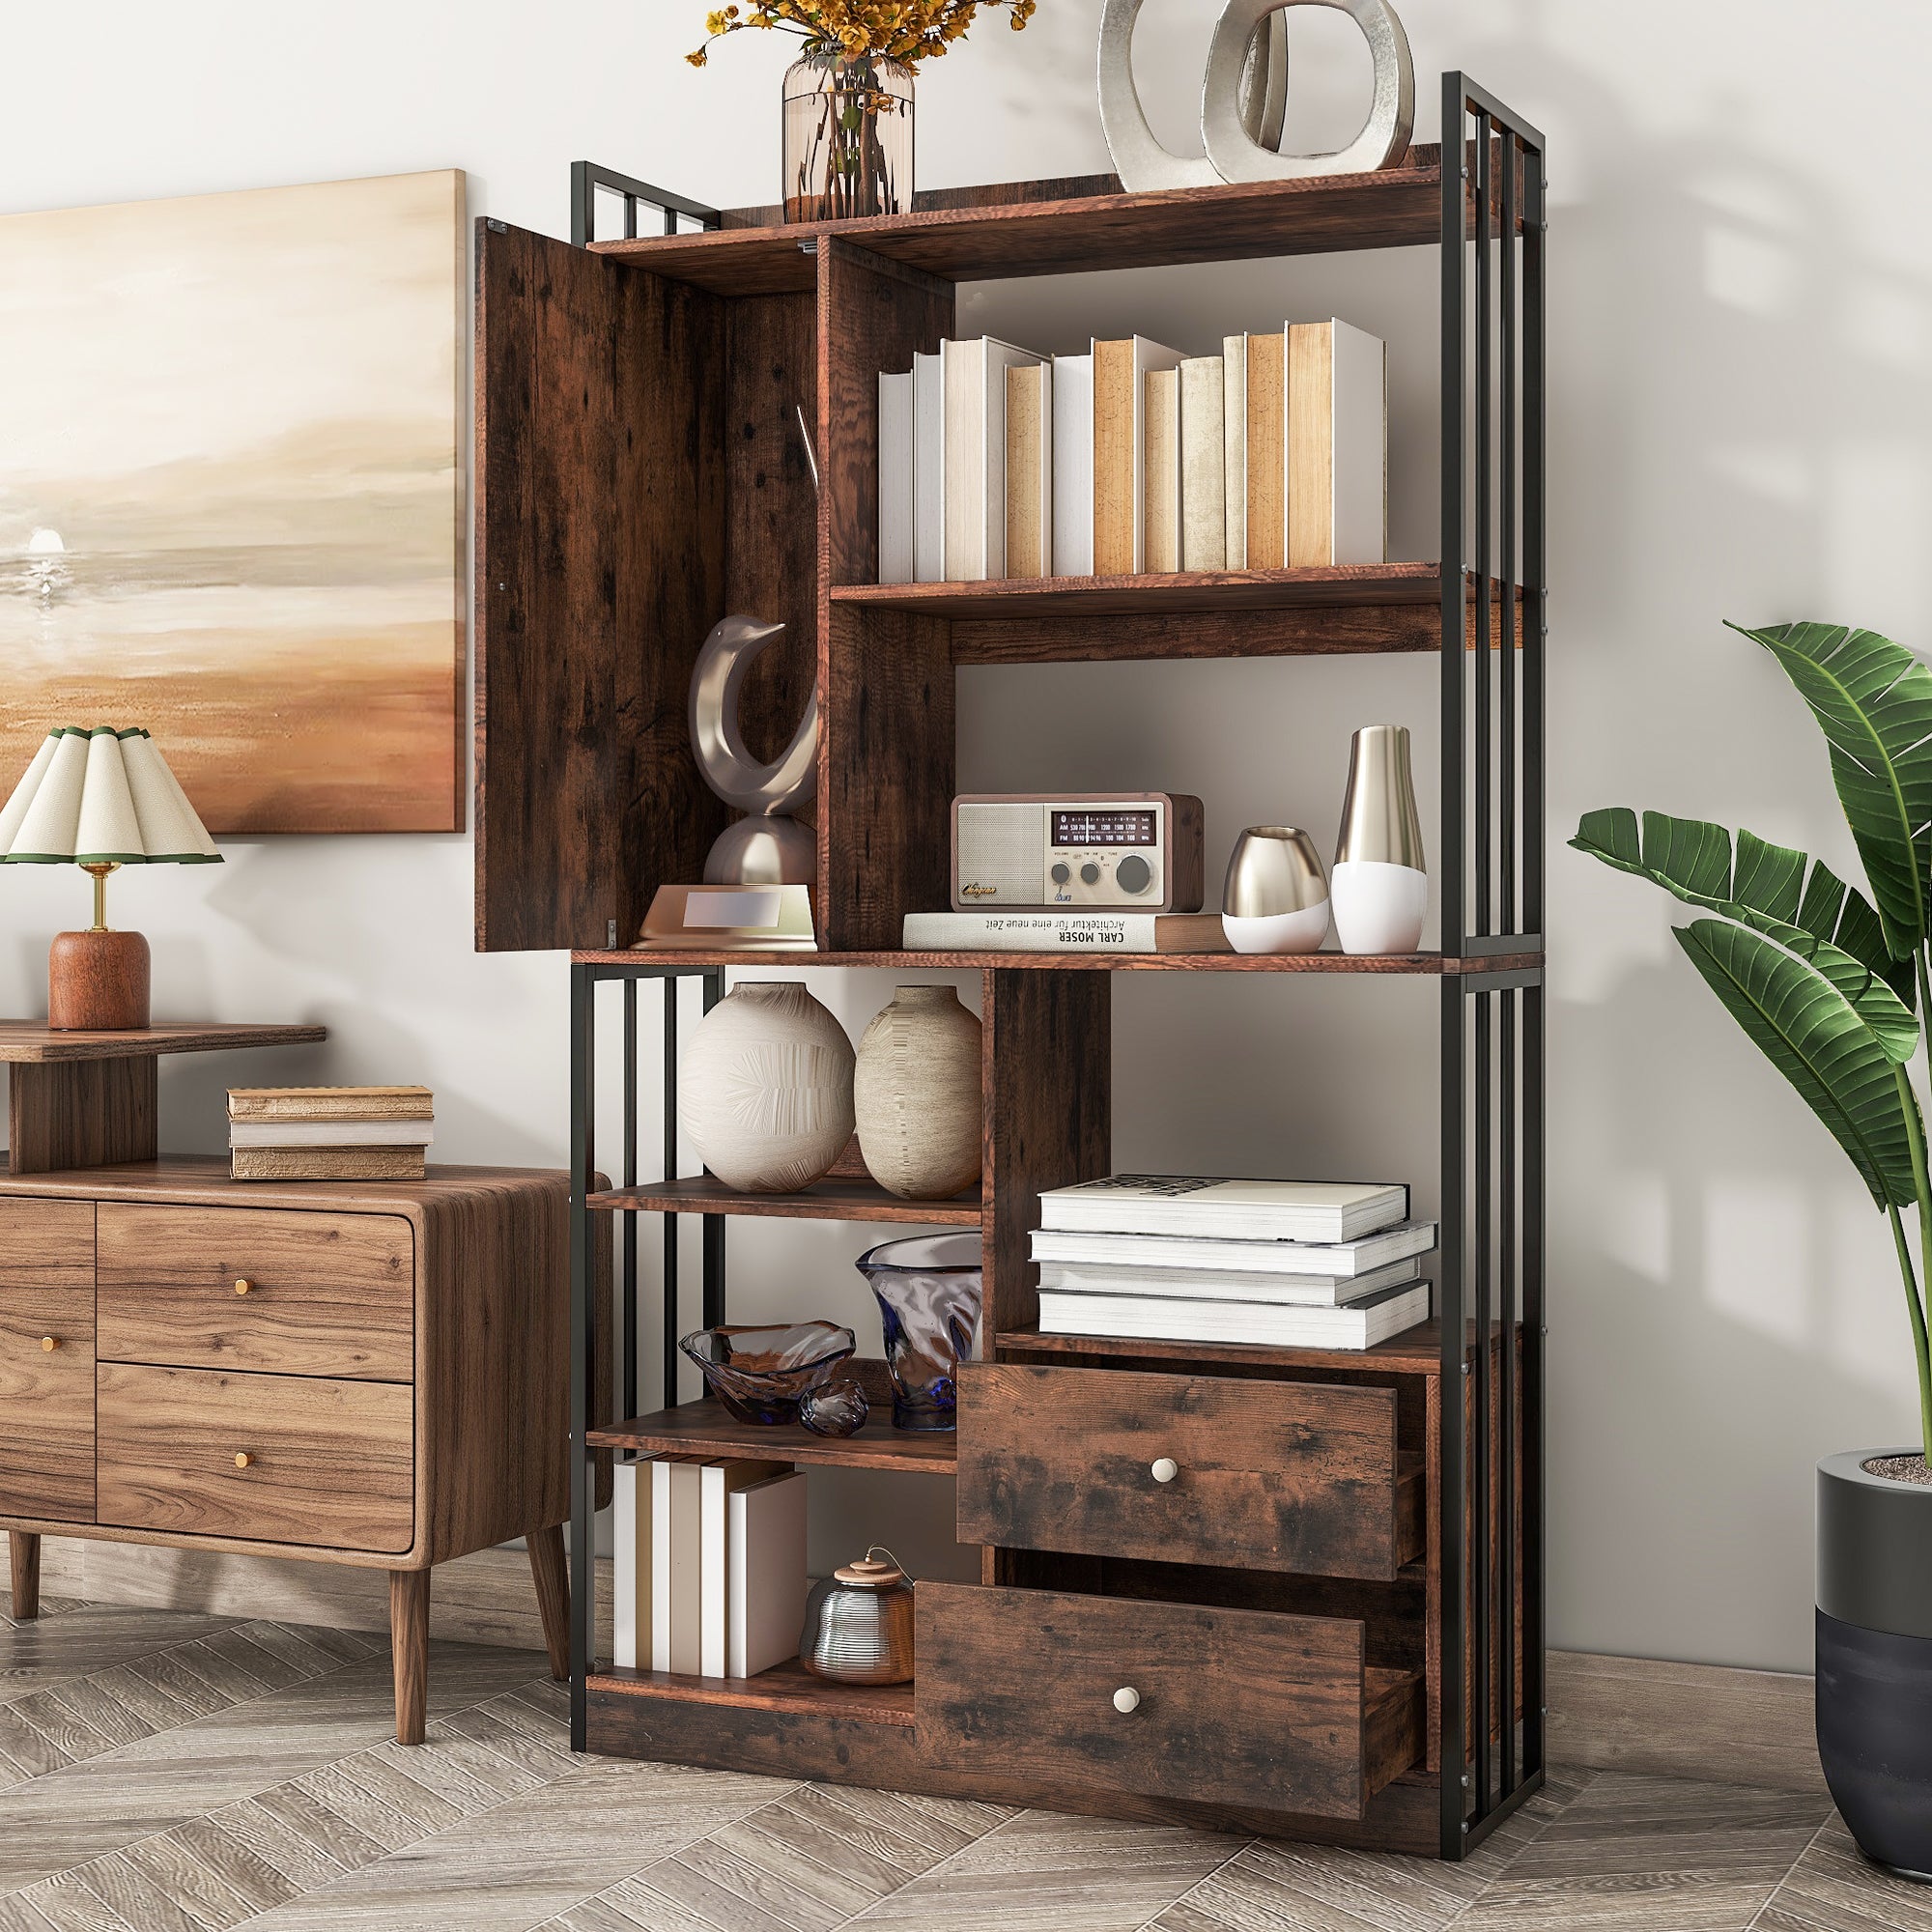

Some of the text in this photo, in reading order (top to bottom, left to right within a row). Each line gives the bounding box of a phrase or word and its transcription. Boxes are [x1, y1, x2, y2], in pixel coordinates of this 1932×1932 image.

[985, 920, 1125, 930] Architektur für eine neue Zeit
[1059, 931, 1124, 942] CARL MOSER
